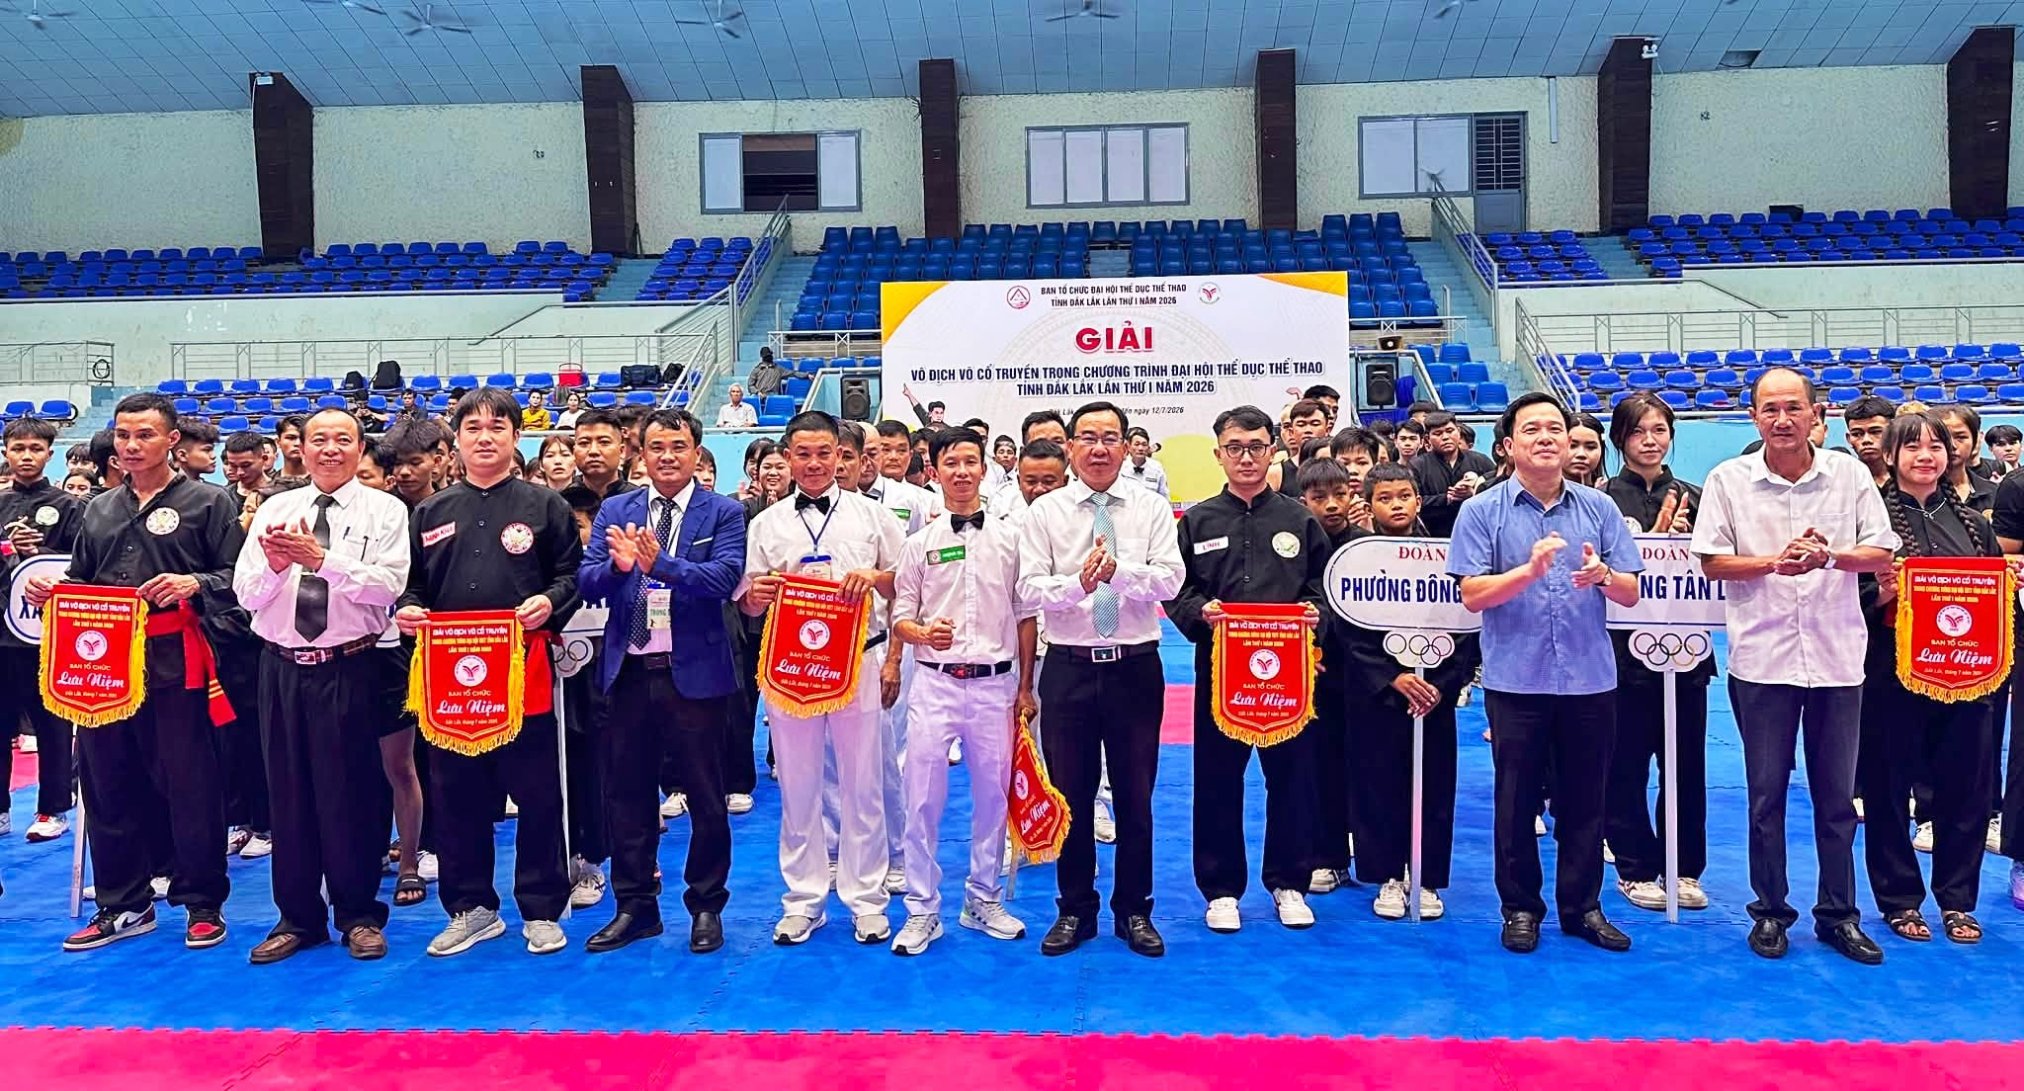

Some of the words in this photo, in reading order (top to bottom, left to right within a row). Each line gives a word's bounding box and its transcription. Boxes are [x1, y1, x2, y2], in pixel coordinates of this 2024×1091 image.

[1041, 286, 1056, 295] BAN
[1069, 284, 1089, 294] CHỨC
[1167, 283, 1187, 293] THAO
[1139, 295, 1157, 305] NĂM
[1159, 296, 1177, 305] 2026
[1075, 320, 1153, 351] GIẢI
[911, 367, 926, 381] VÔ
[929, 368, 955, 384] ĐỊCH
[977, 364, 992, 380] CỔ
[1043, 366, 1080, 379] TRONG
[1084, 364, 1130, 378] CHƯƠNG
[1134, 362, 1168, 377] TRÌNH
[1171, 363, 1190, 379] ĐẠI
[1194, 362, 1213, 379] HỘI
[1217, 358, 1239, 375] THỂ
[1242, 362, 1265, 378] DỤC
[1269, 357, 1291, 375] THỂ
[1293, 361, 1323, 374] THAO
[1017, 380, 1043, 396] TỈNH
[1046, 380, 1069, 395] ĐẮK
[1072, 379, 1094, 395] LẮK
[1098, 378, 1120, 395] LẦN
[1124, 378, 1146, 394] THỨ
[1156, 379, 1183, 393] NĂM
[1187, 380, 1215, 393] 2026
[1152, 407, 1184, 415] 12/7/2026
[1399, 543, 1446, 561] ĐOÀN
[1642, 544, 1689, 561] ĐOÀN
[1341, 569, 1411, 602] PHƯỜNG
[1415, 574, 1462, 603] ĐÔNG
[1673, 569, 1711, 600] TÂN
[1915, 647, 1946, 663] Lưu
[1950, 648, 1993, 668] Niệm
[56, 671, 83, 686] Lưu
[1229, 691, 1256, 706] Lưu
[436, 699, 463, 714] Lưu
[466, 699, 506, 717] Niệm
